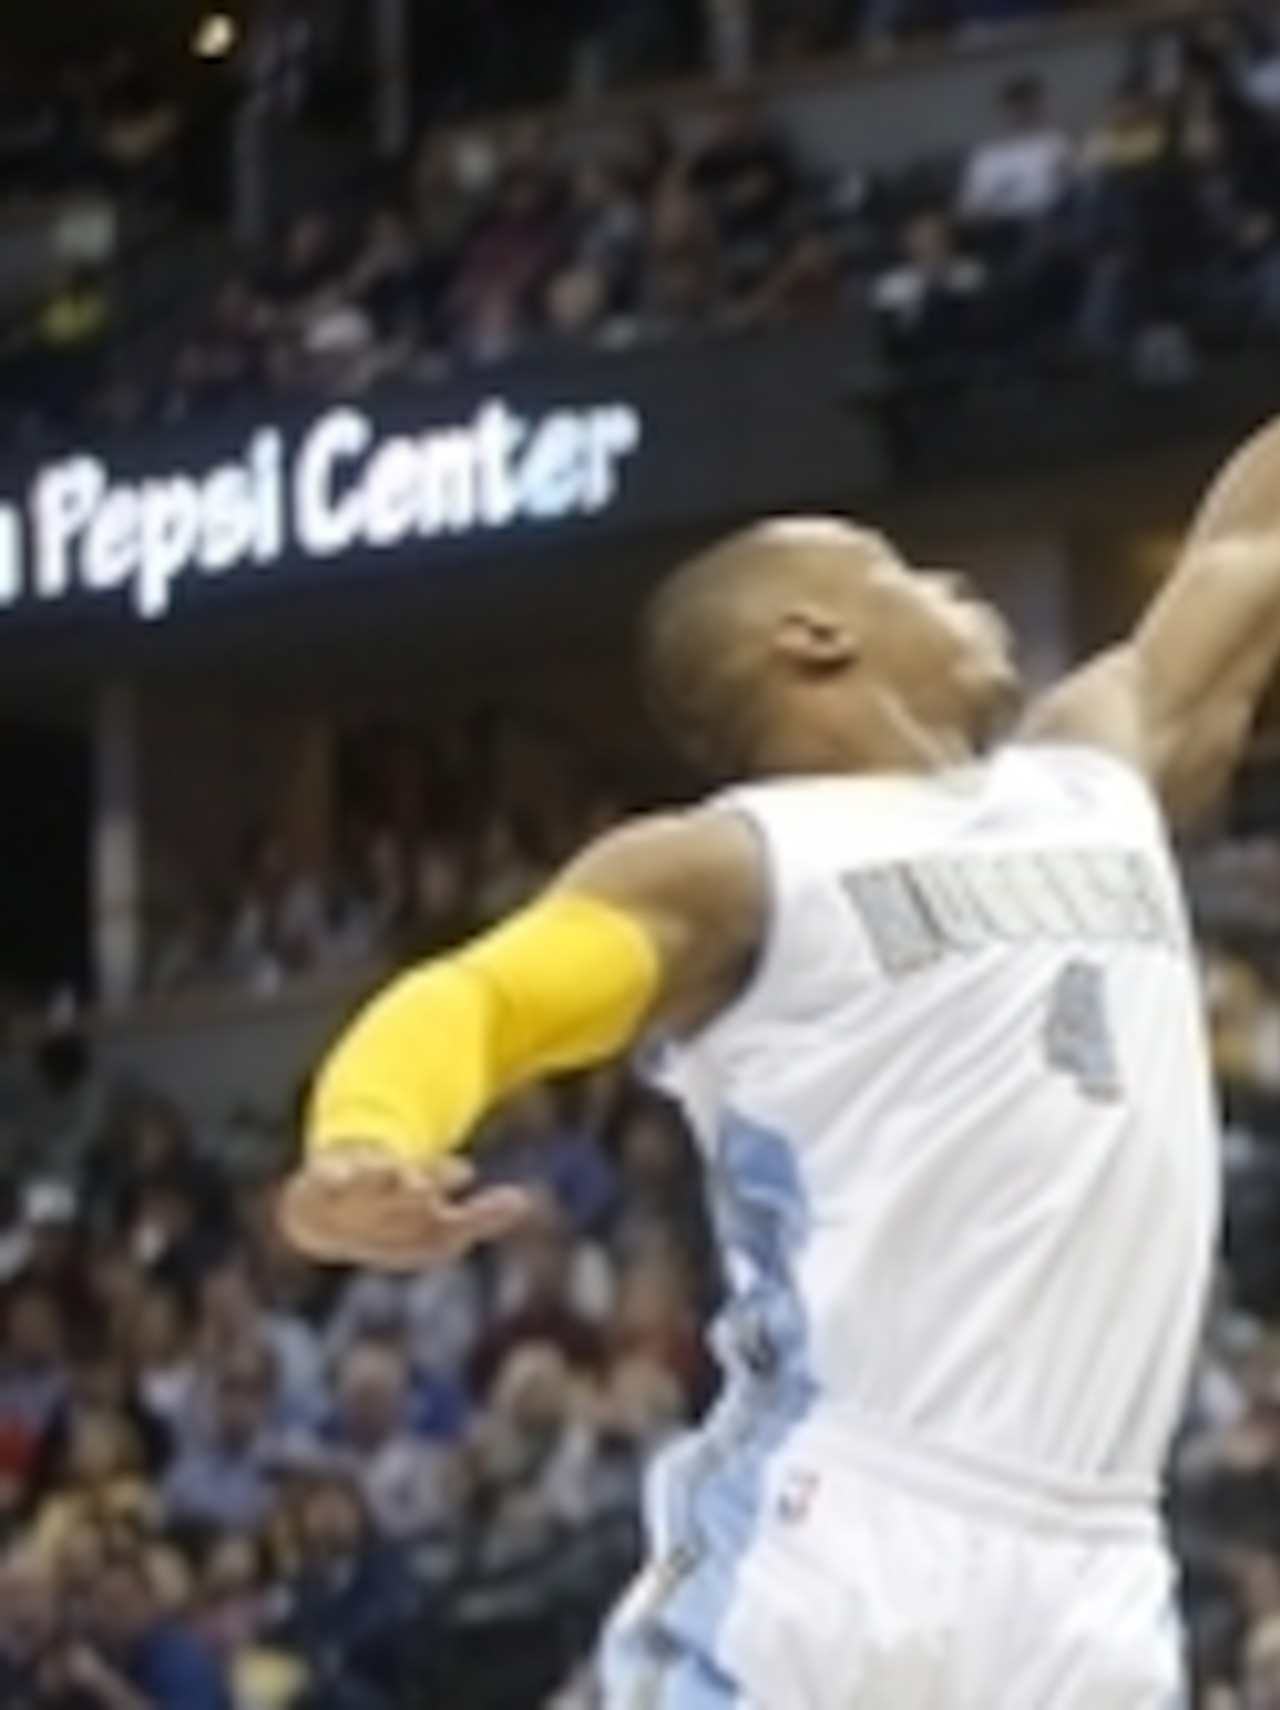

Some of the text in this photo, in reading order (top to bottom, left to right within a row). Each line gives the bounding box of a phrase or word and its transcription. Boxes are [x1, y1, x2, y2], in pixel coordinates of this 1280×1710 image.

[33, 429, 282, 616] Pepsi
[294, 401, 638, 554] Center
[1044, 957, 1124, 1102] 4
